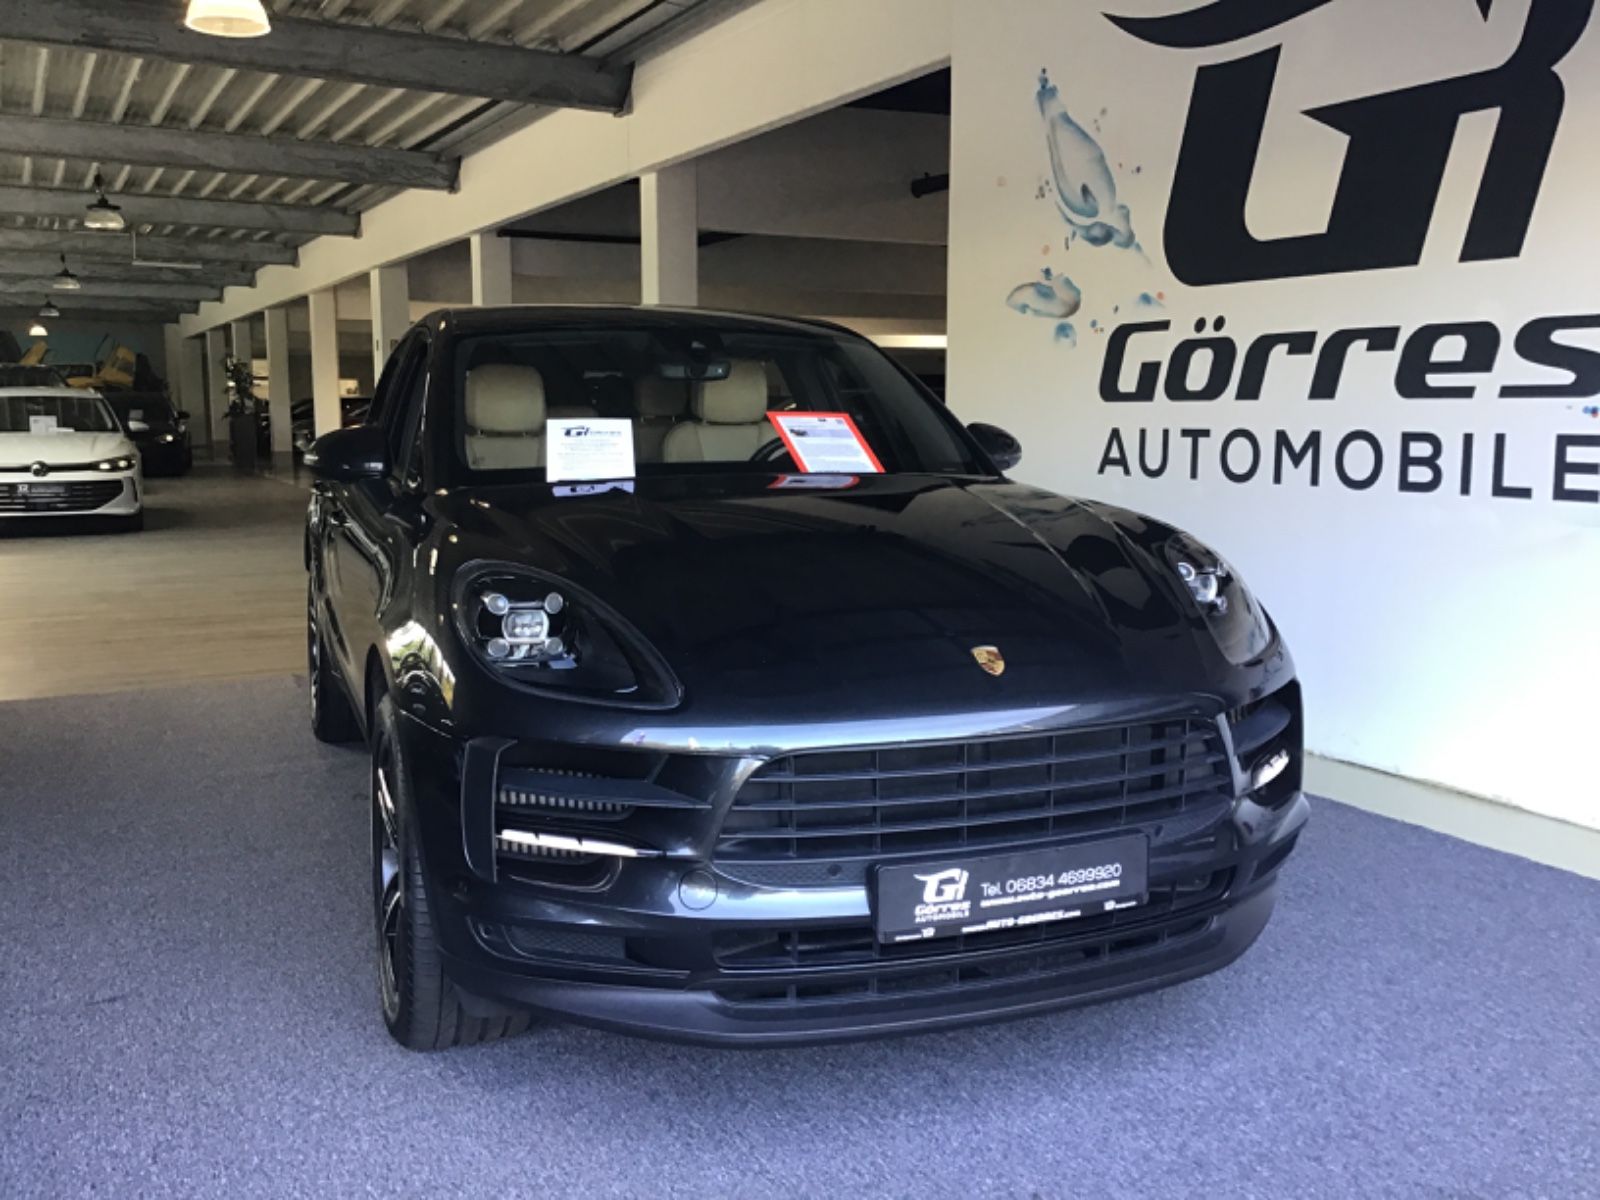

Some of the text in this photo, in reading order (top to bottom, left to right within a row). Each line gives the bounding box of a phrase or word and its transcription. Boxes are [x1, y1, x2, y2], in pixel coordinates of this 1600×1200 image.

[1098, 314, 1600, 402] Görres
[1098, 427, 1600, 503] AUTOMOBILE
[1005, 874, 1055, 894] 06834
[1057, 863, 1122, 885] 4699920
